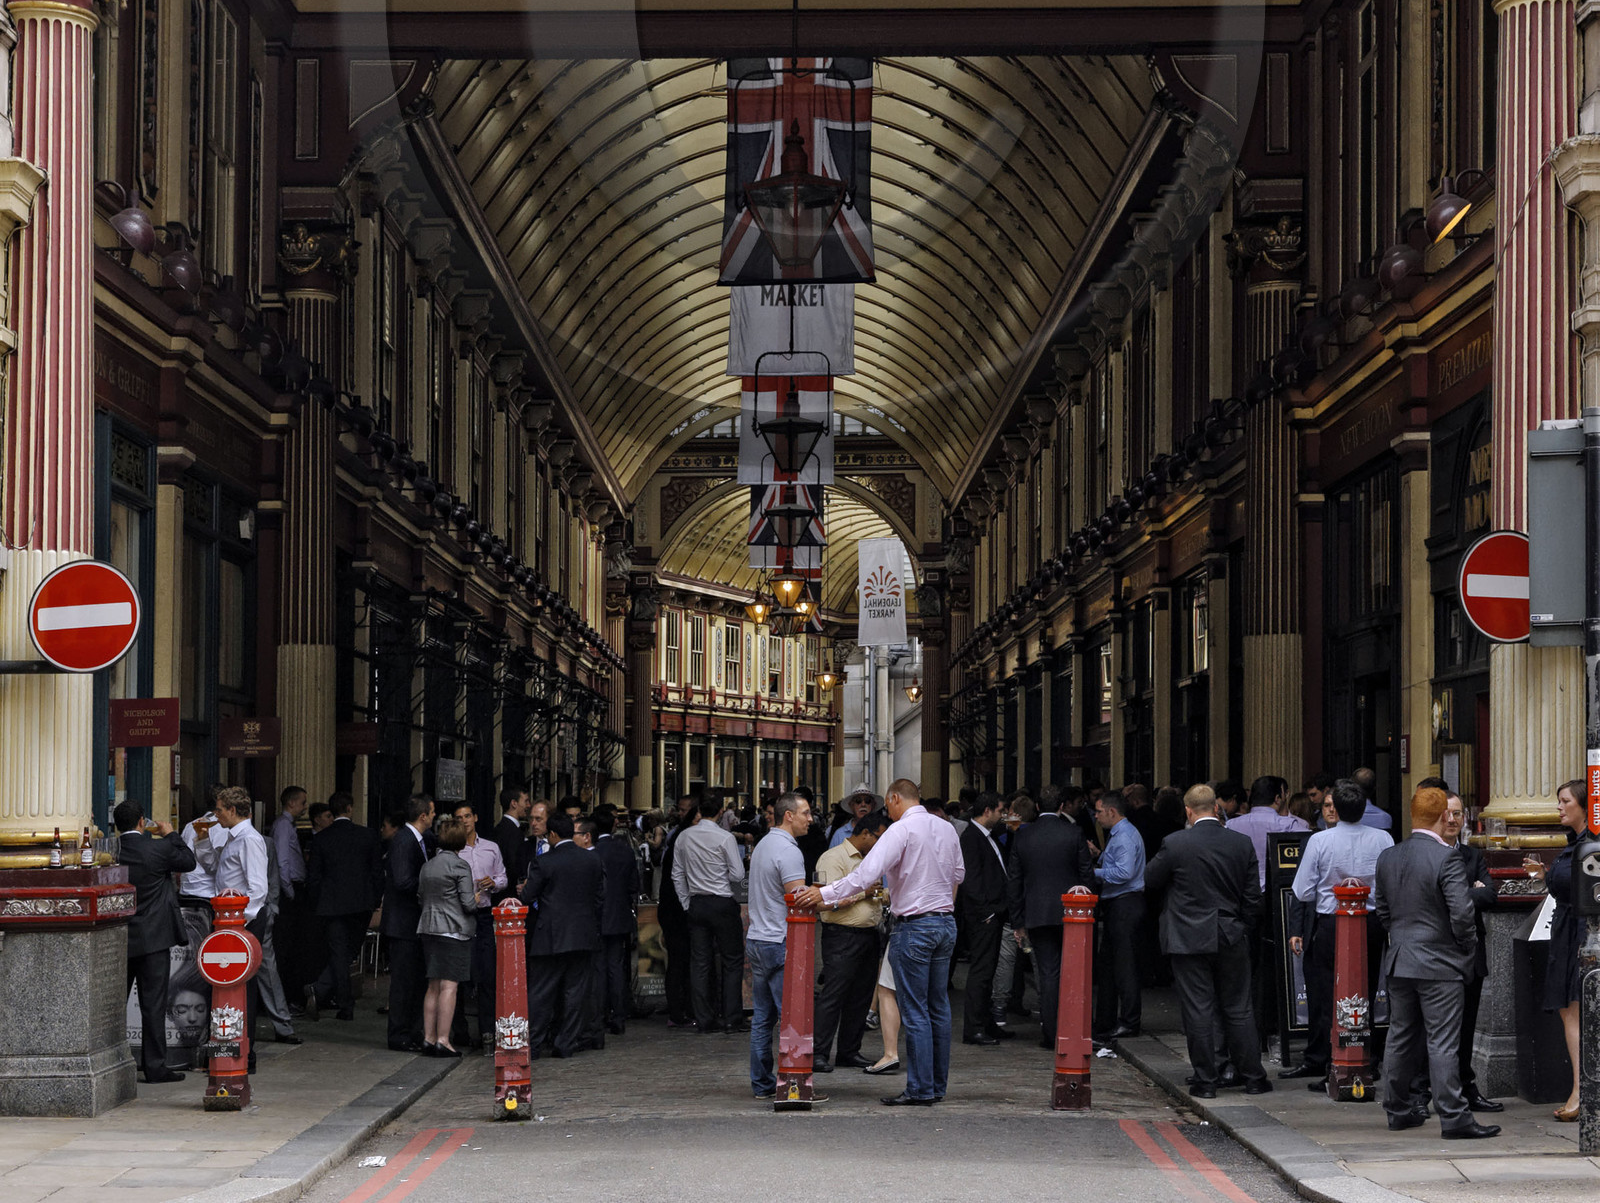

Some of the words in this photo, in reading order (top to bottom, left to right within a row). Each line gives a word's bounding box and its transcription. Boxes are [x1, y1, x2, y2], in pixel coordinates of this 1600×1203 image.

[760, 284, 826, 307] MARKET
[1465, 490, 1491, 533] MO
[123, 709, 166, 717] NICHOLSON
[137, 718, 153, 726] AND
[129, 728, 160, 736] GRIFFIN
[1591, 770, 1600, 796] butts
